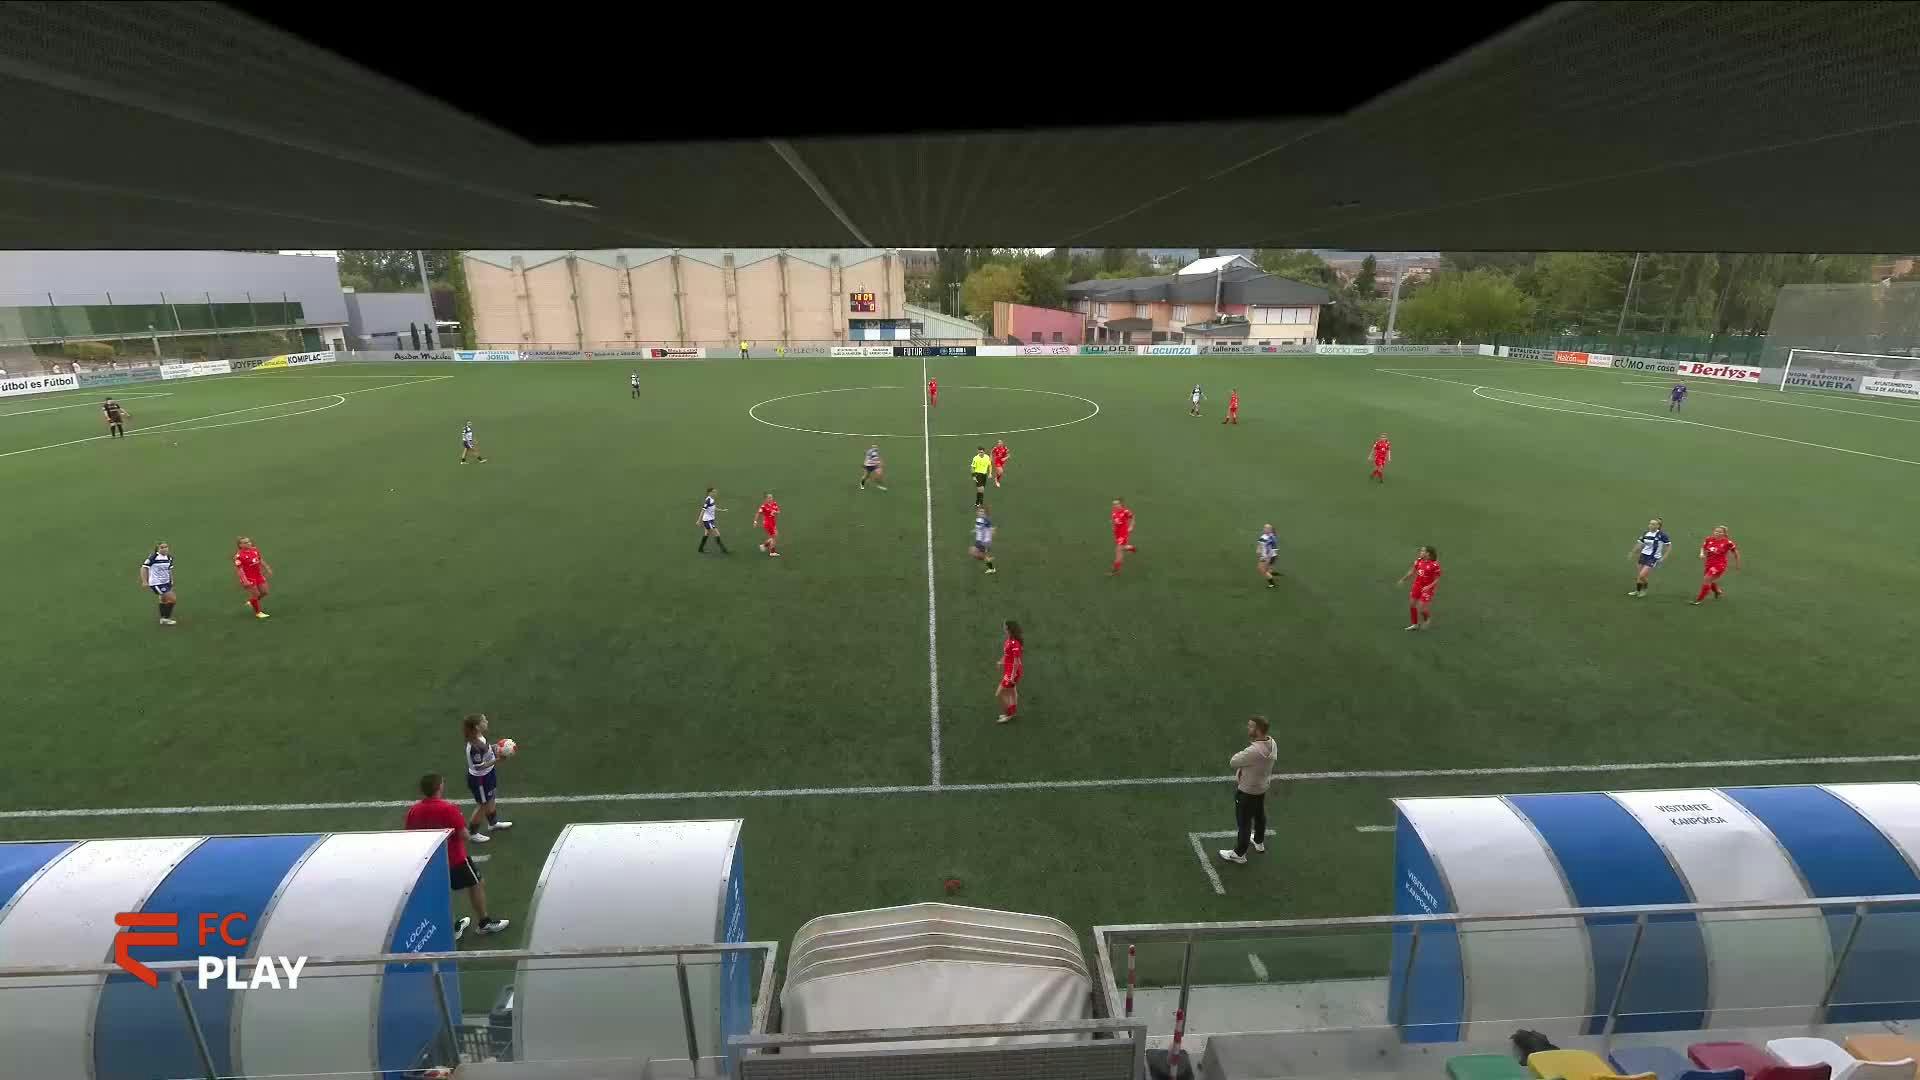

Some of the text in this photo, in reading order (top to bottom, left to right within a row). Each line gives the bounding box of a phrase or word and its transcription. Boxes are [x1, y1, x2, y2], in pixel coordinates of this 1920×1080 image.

[231, 359, 264, 369] JOYFER
[287, 353, 321, 364] KOMIPLAC
[1690, 363, 1747, 379] Berlys
[0, 380, 28, 391] útbol
[30, 381, 42, 389] es
[44, 376, 74, 387] Fútbol
[1654, 803, 1712, 813] VISITANTE
[1407, 868, 1438, 909] VISITANTE
[405, 918, 430, 949] LOCAL
